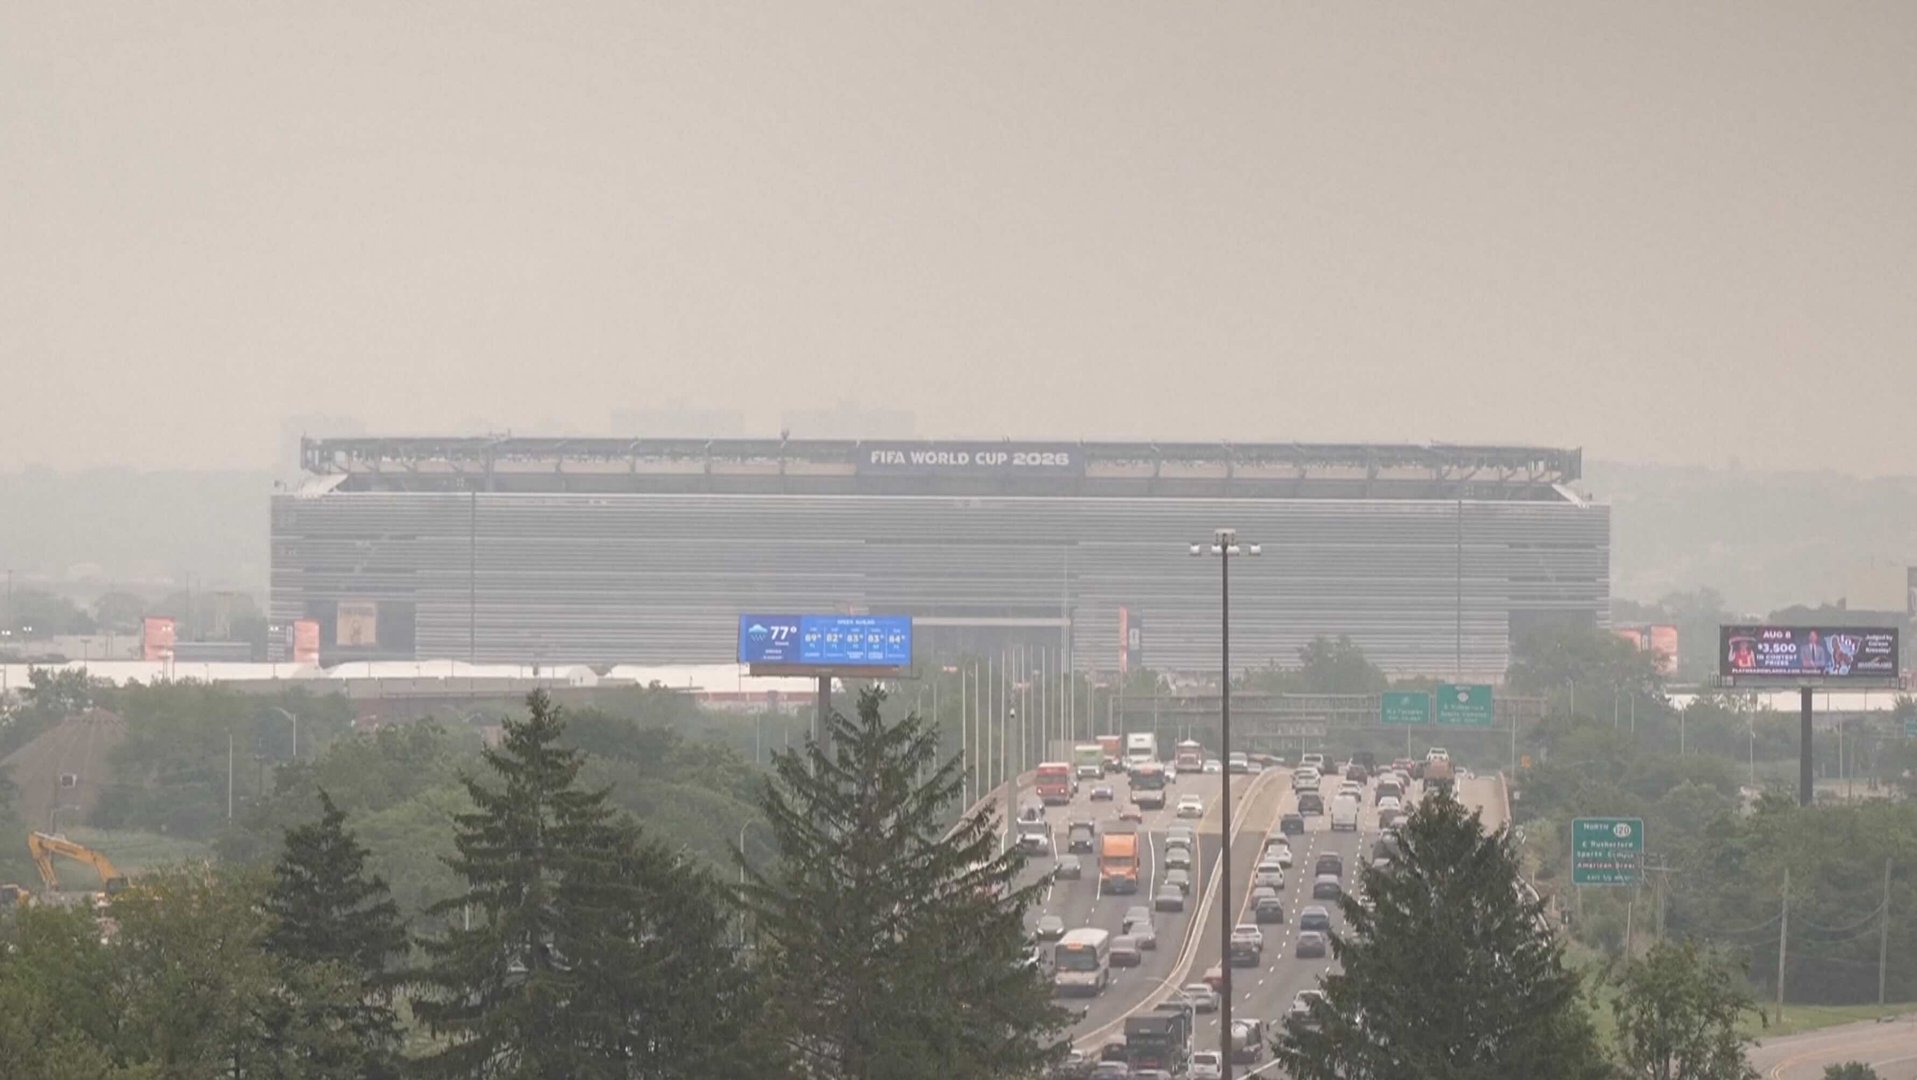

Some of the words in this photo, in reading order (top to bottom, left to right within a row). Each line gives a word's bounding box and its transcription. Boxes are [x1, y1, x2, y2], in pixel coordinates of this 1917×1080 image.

[871, 451, 905, 465] FIFA
[910, 451, 969, 465] WORLD
[975, 452, 1007, 465] CUP
[1012, 453, 1069, 466] 2026
[1763, 630, 1783, 639] AUG
[1577, 862, 1612, 870] American
